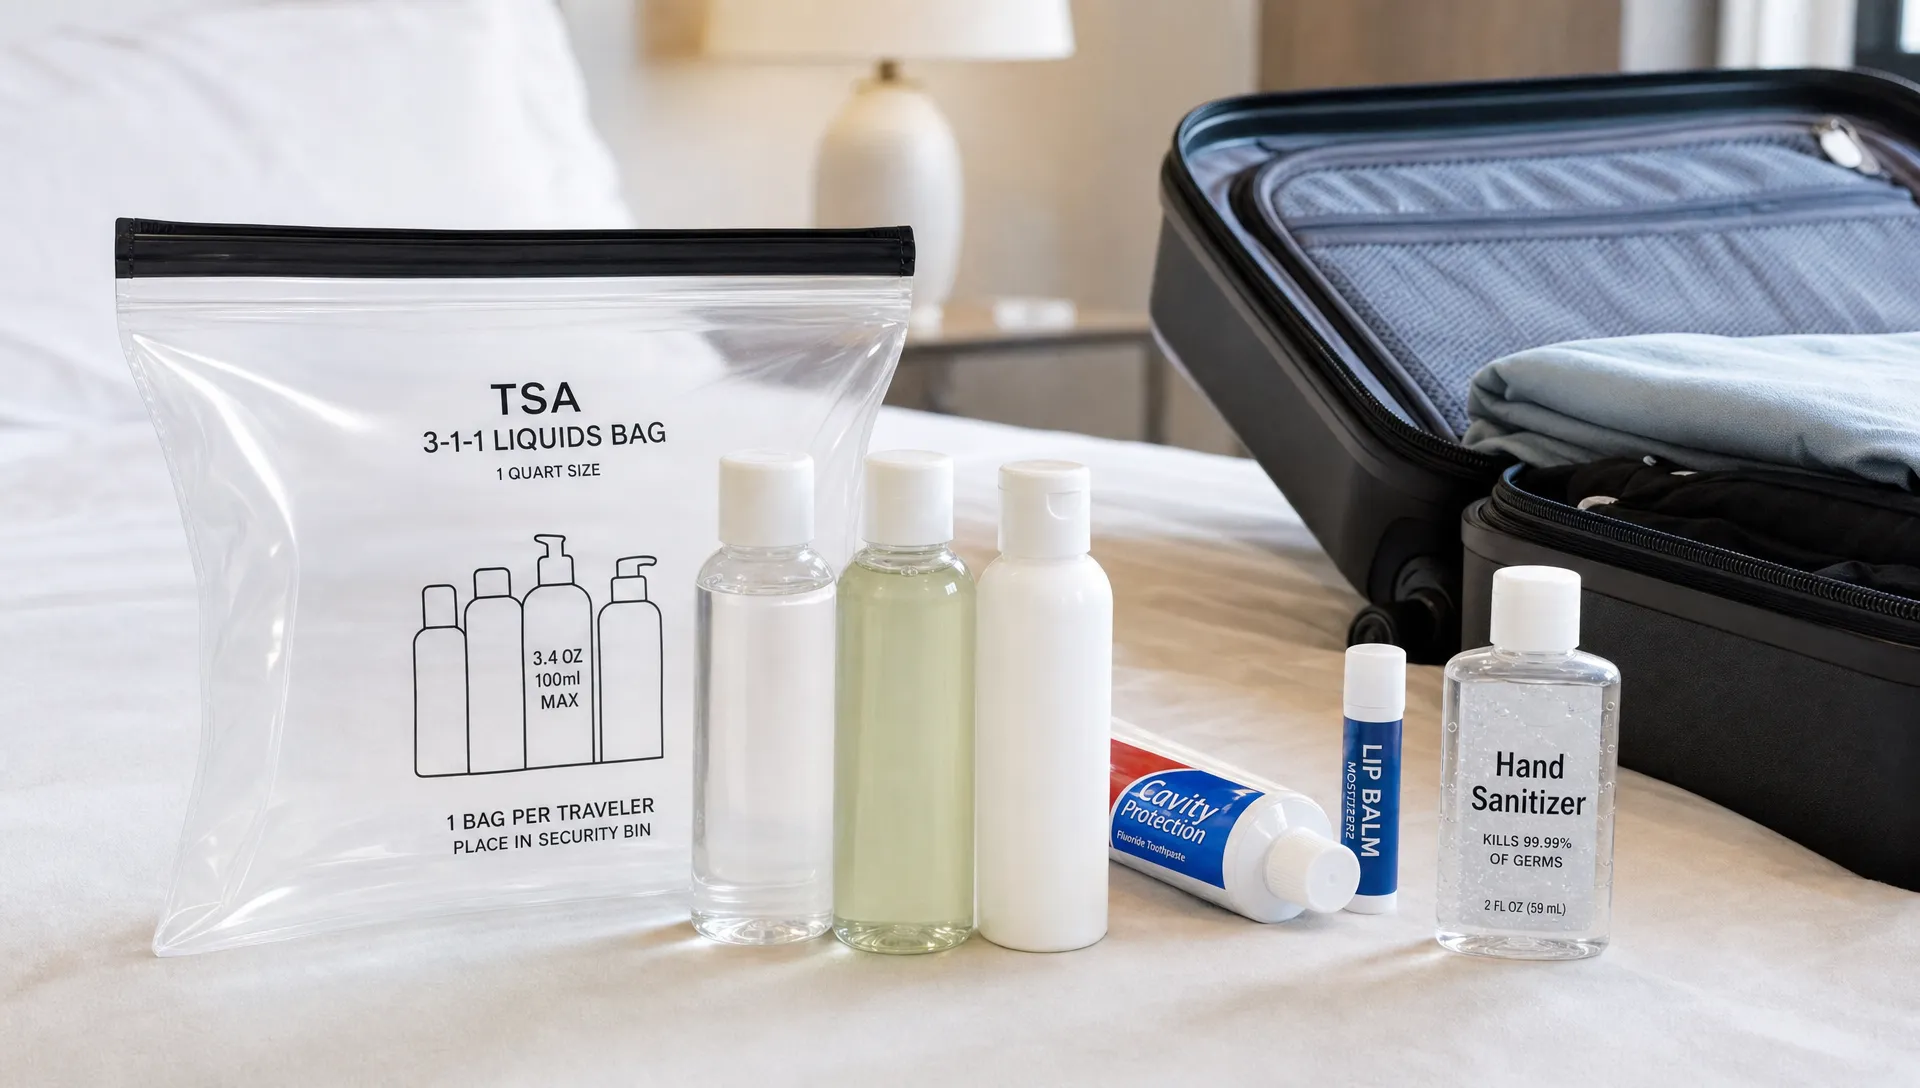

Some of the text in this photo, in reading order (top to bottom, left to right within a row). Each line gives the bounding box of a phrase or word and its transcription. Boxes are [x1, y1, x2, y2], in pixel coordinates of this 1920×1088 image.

[490, 381, 581, 415] TSA
[423, 421, 666, 453] 3-1-1 LIQUIDS BAG
[497, 463, 600, 480] 1 QUART SIZE
[533, 649, 583, 666] 3.4 OZ
[535, 671, 580, 688] 100ml
[541, 693, 579, 710] MAX
[1496, 751, 1564, 779] Hand
[447, 797, 654, 831] 1 BAG PER TRAVELER
[1139, 779, 1219, 826] Cavity
[1361, 744, 1383, 857] LIP BALM
[1471, 785, 1587, 815] Sanitizer
[1120, 799, 1206, 845] Protection
[453, 823, 651, 854] PLACE IN SECURITY BIN
[1116, 830, 1186, 862] Fluoride Toothpaste
[1483, 833, 1572, 849] KILLS 99.99%
[1490, 853, 1563, 868] OF GERMS
[1484, 900, 1567, 916] 2 FL OZ (59 mL)
